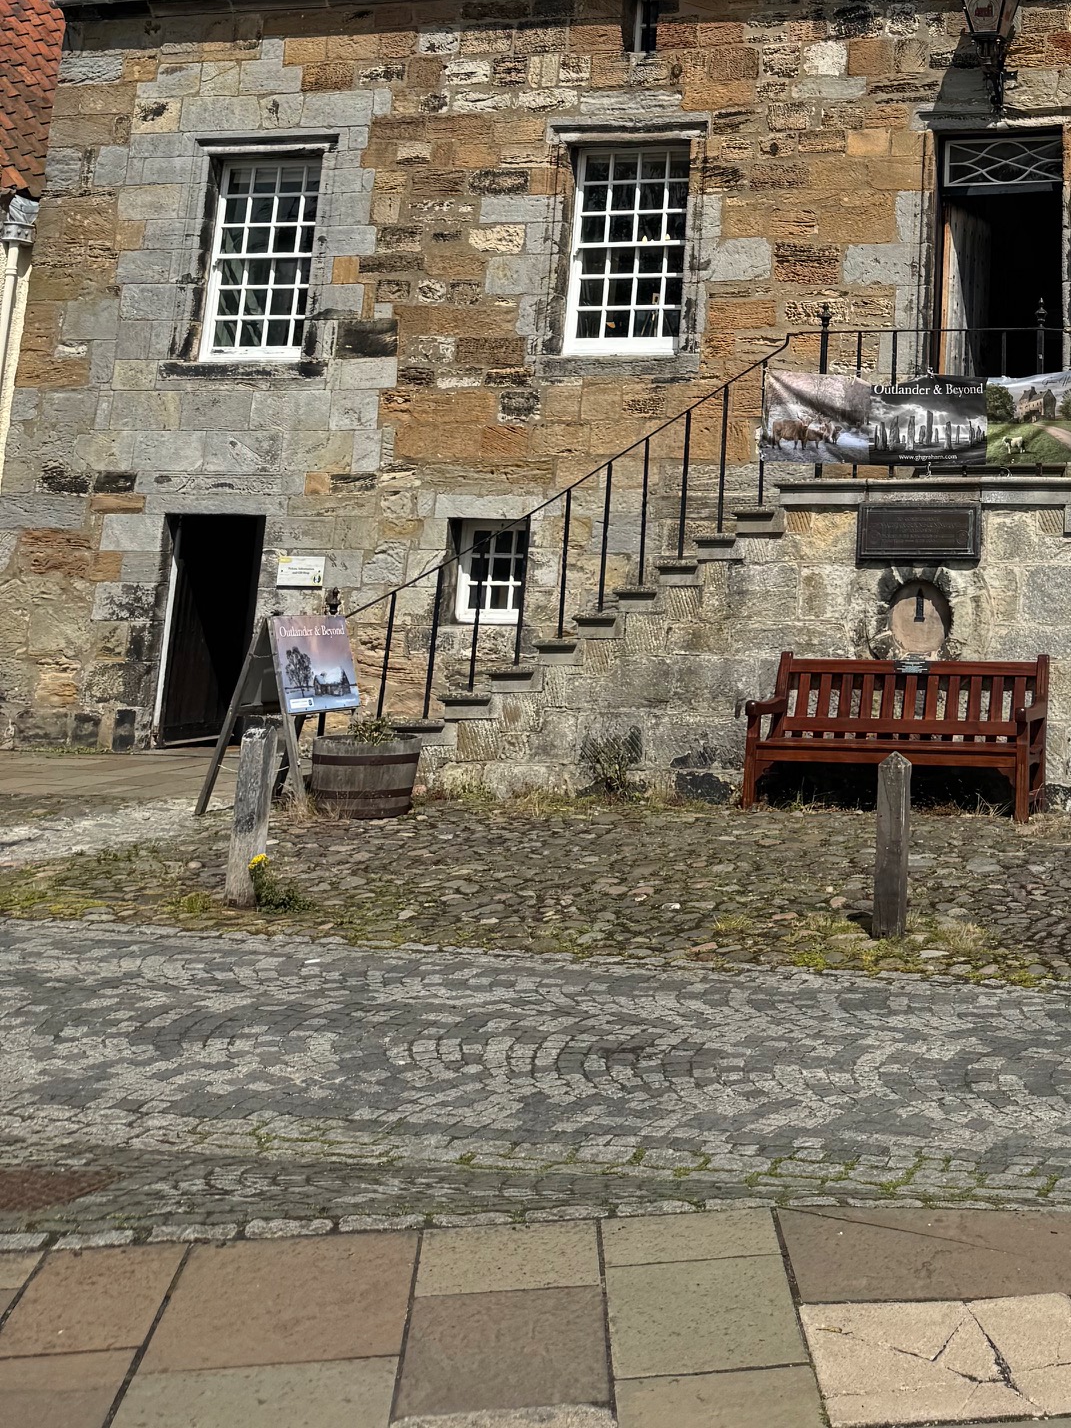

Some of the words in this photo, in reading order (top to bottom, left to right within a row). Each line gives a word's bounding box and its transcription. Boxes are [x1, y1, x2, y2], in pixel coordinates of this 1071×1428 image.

[873, 383, 931, 395] Outlander
[933, 384, 943, 395] &
[945, 382, 984, 397] Beyond
[279, 625, 314, 638] Outlander
[314, 625, 321, 636] &
[320, 624, 345, 639] Beyond
